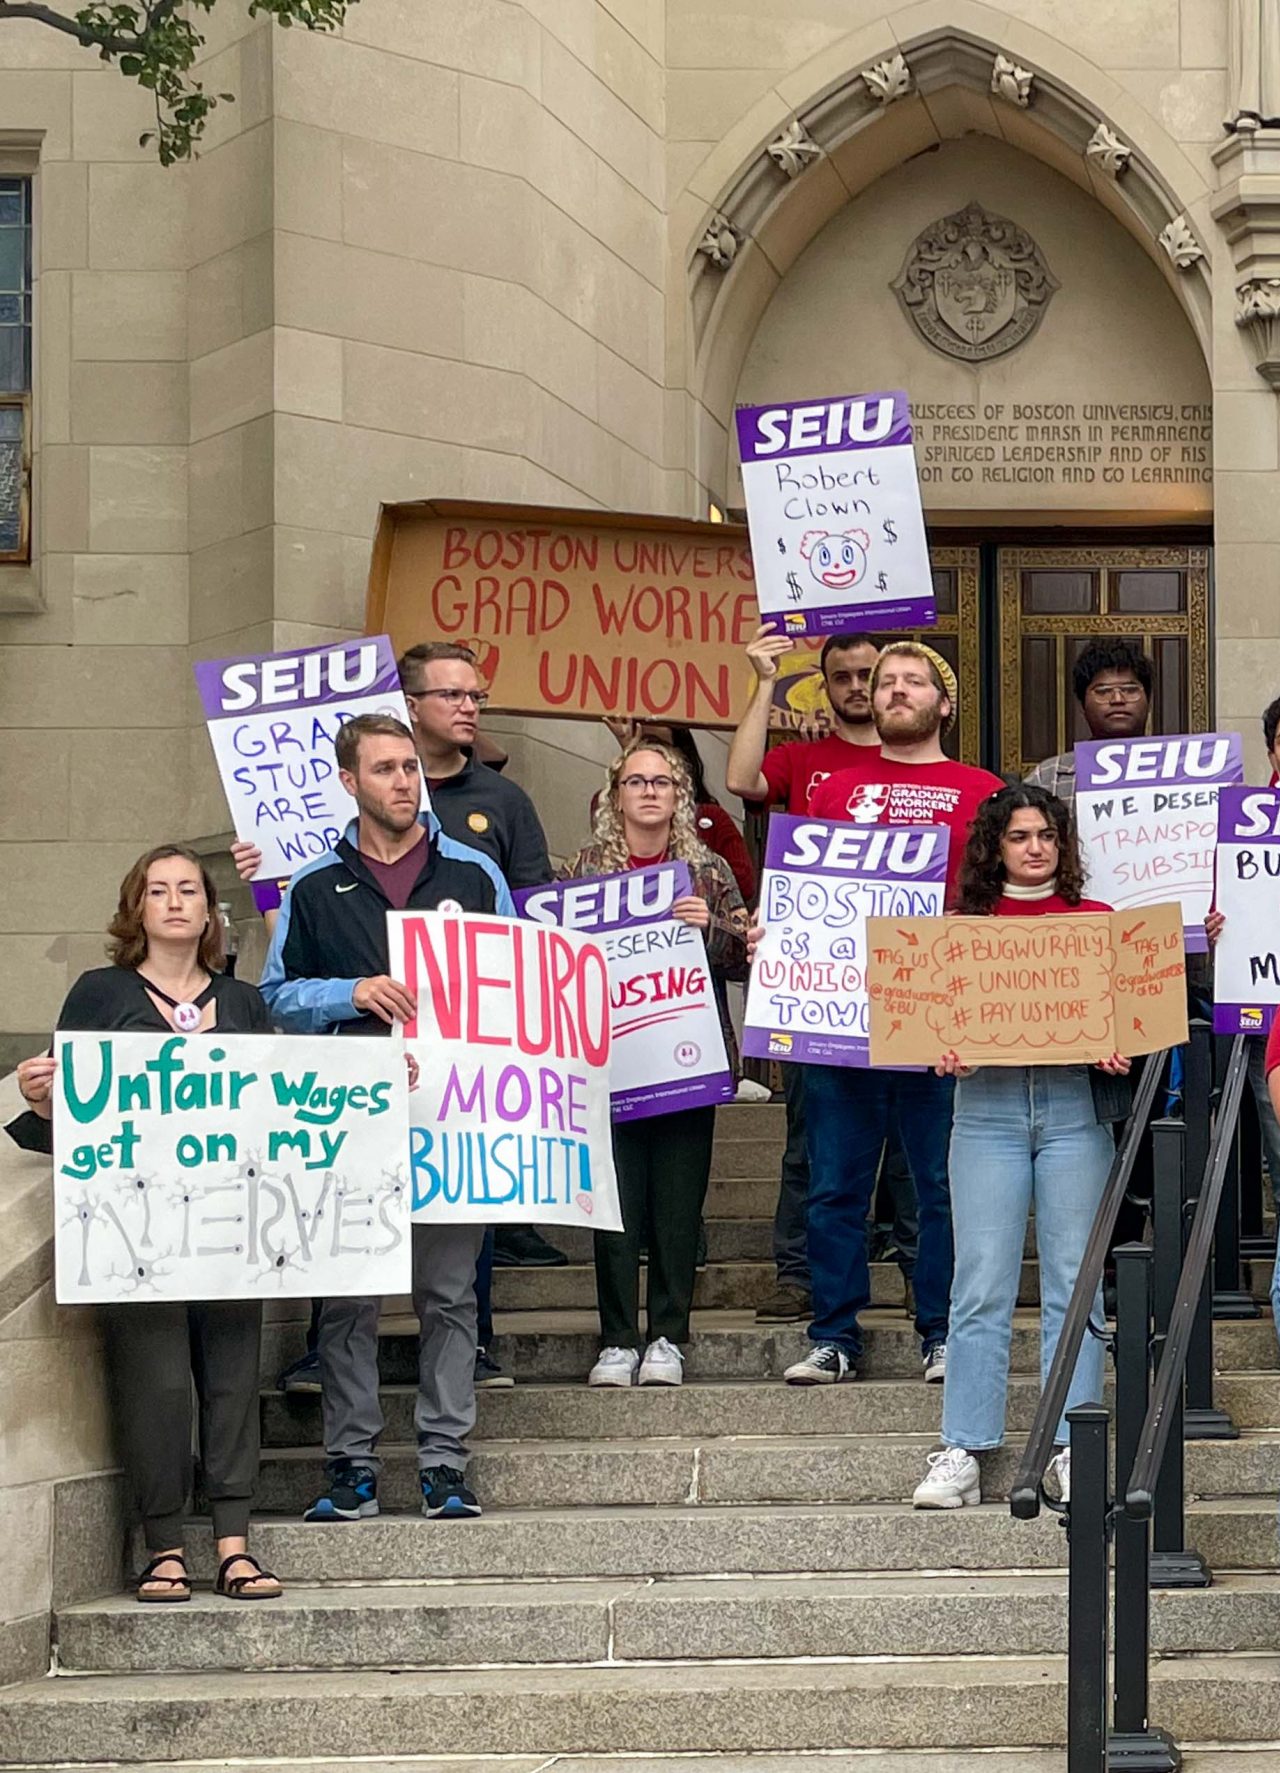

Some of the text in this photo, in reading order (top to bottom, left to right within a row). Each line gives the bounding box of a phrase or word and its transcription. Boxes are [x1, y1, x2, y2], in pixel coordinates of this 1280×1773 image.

[753, 397, 897, 456] SEIU
[983, 404, 1004, 420] OF
[1013, 404, 1075, 420] BOSTON
[932, 425, 1019, 441] PRESIDENT
[1026, 425, 1081, 441] MARSH
[1088, 425, 1103, 441] IN
[1112, 425, 1213, 442] PERMANENT
[924, 446, 1206, 462] SPIRITED LEADERSHIP AND OF HIS
[775, 462, 881, 493] Robert
[952, 467, 974, 483] TO
[982, 467, 1054, 484] RELIGION
[1062, 467, 1095, 484] AND
[1103, 467, 1125, 484] TO
[1131, 467, 1213, 484] LEARNING
[784, 497, 872, 521] Clown
[442, 527, 598, 573] BOSTON
[431, 574, 760, 645] GRAD WORKE
[221, 644, 377, 711] SEIU
[539, 650, 730, 719] UNION
[233, 758, 333, 796] STUD
[1090, 739, 1231, 785] SEIU
[255, 792, 336, 827] ARE
[889, 808, 934, 819] UNION
[890, 789, 959, 805] GRADUATE
[890, 798, 954, 813] WORKERS
[1092, 796, 1139, 822] WE
[783, 824, 938, 874] SEIU
[1091, 821, 1216, 854] TRANSPO
[524, 869, 675, 930] SEIU
[766, 874, 938, 928] BOSTON
[780, 926, 857, 961] is a
[872, 948, 929, 969] TAG US
[1127, 931, 1178, 955] TAG US
[759, 959, 869, 992] UNIO
[892, 966, 916, 982] AT
[1142, 953, 1158, 969] AT
[402, 917, 611, 1067] NEURO
[62, 1036, 258, 1124] Unfair
[436, 1062, 588, 1135] MORE
[60, 1120, 349, 1180] get on my
[410, 1126, 593, 1212] BULLSHIT!
[60, 1147, 411, 1297] NERVES
